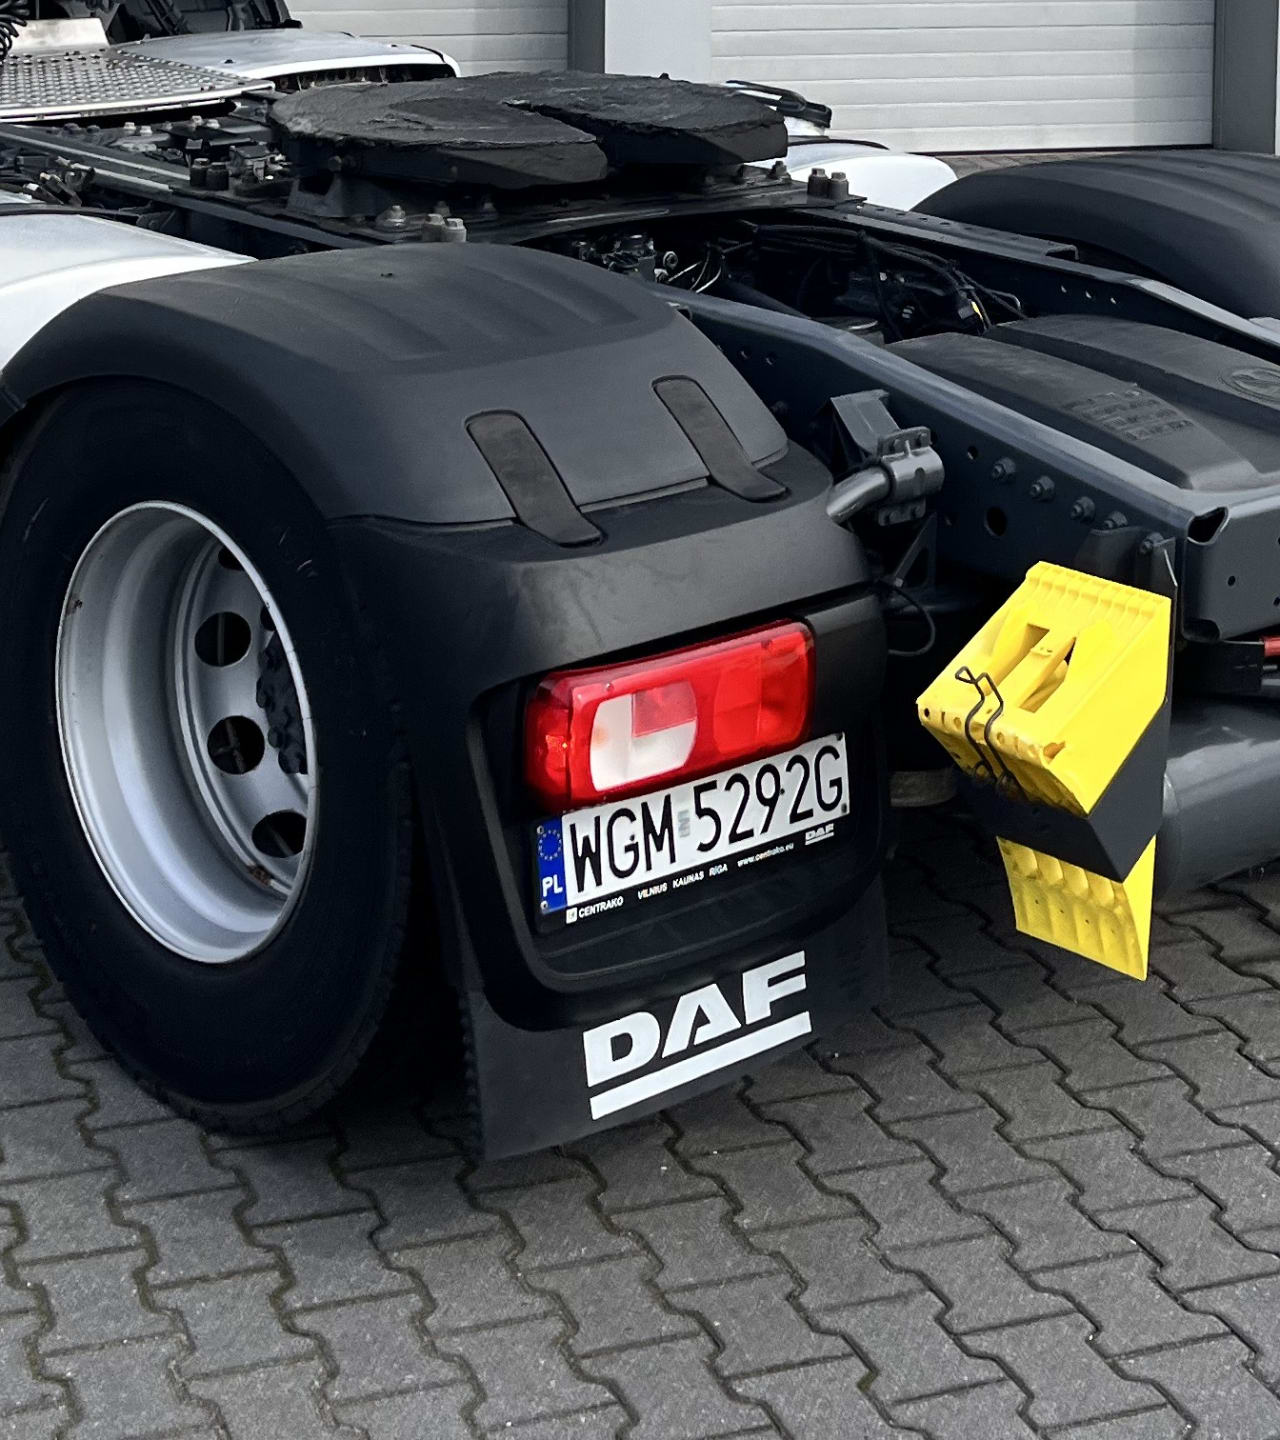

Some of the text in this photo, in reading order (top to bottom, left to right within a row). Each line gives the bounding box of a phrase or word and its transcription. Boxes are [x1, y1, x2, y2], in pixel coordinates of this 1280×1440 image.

[569, 745, 843, 893] WGM 5292G
[805, 823, 835, 844] DAF
[542, 874, 563, 897] PL
[578, 896, 624, 918] CENTRAKO
[637, 882, 668, 900] VILNIUS
[582, 950, 807, 1087] DAF
